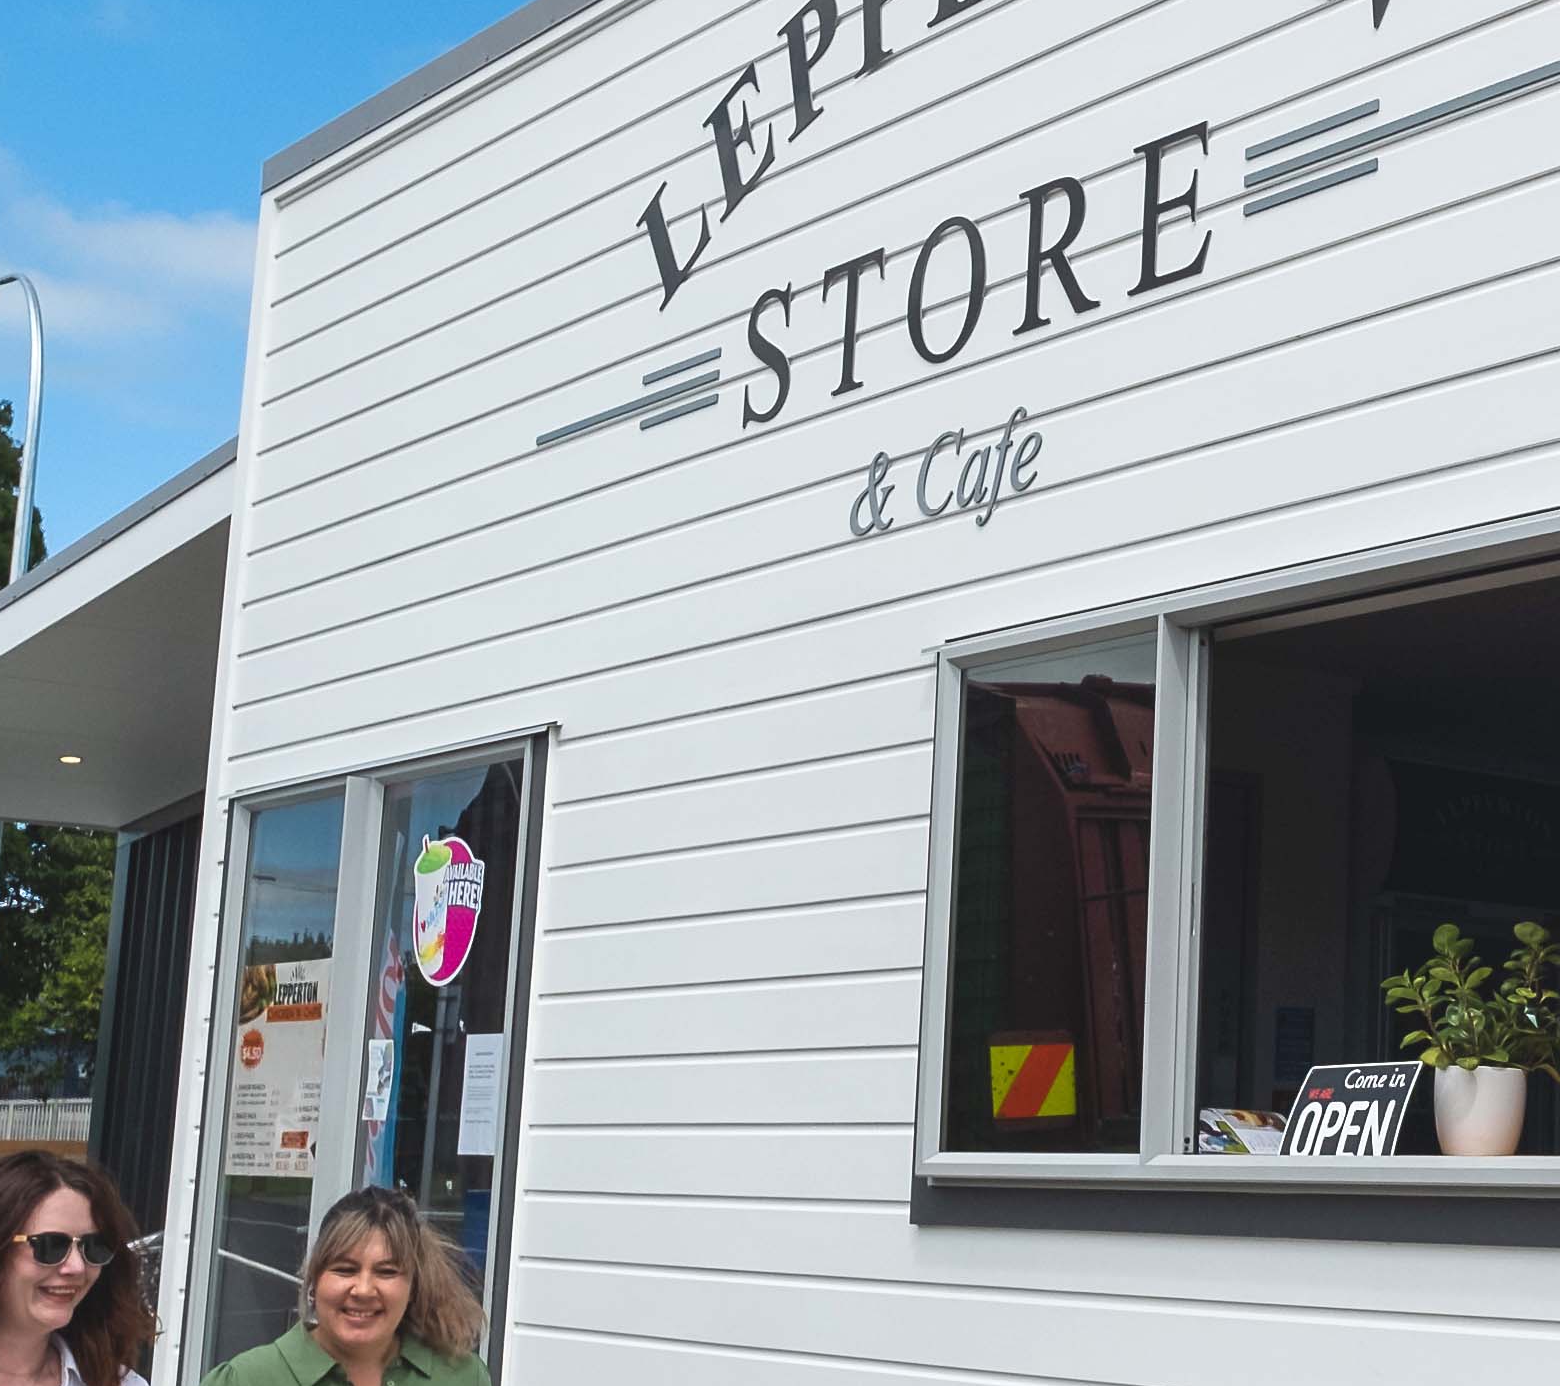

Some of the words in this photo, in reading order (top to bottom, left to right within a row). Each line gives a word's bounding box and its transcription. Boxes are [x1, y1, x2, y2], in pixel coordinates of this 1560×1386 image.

[740, 120, 1214, 431] STORE
[849, 450, 896, 538] &
[915, 405, 1044, 529] Cafe
[443, 862, 483, 884] AVAILABLE
[448, 880, 482, 912] HERE!
[273, 980, 319, 1006] LEPPERTON
[1344, 1068, 1388, 1089] Come
[1389, 1067, 1406, 1088] in
[1289, 1099, 1397, 1157] OPEN
